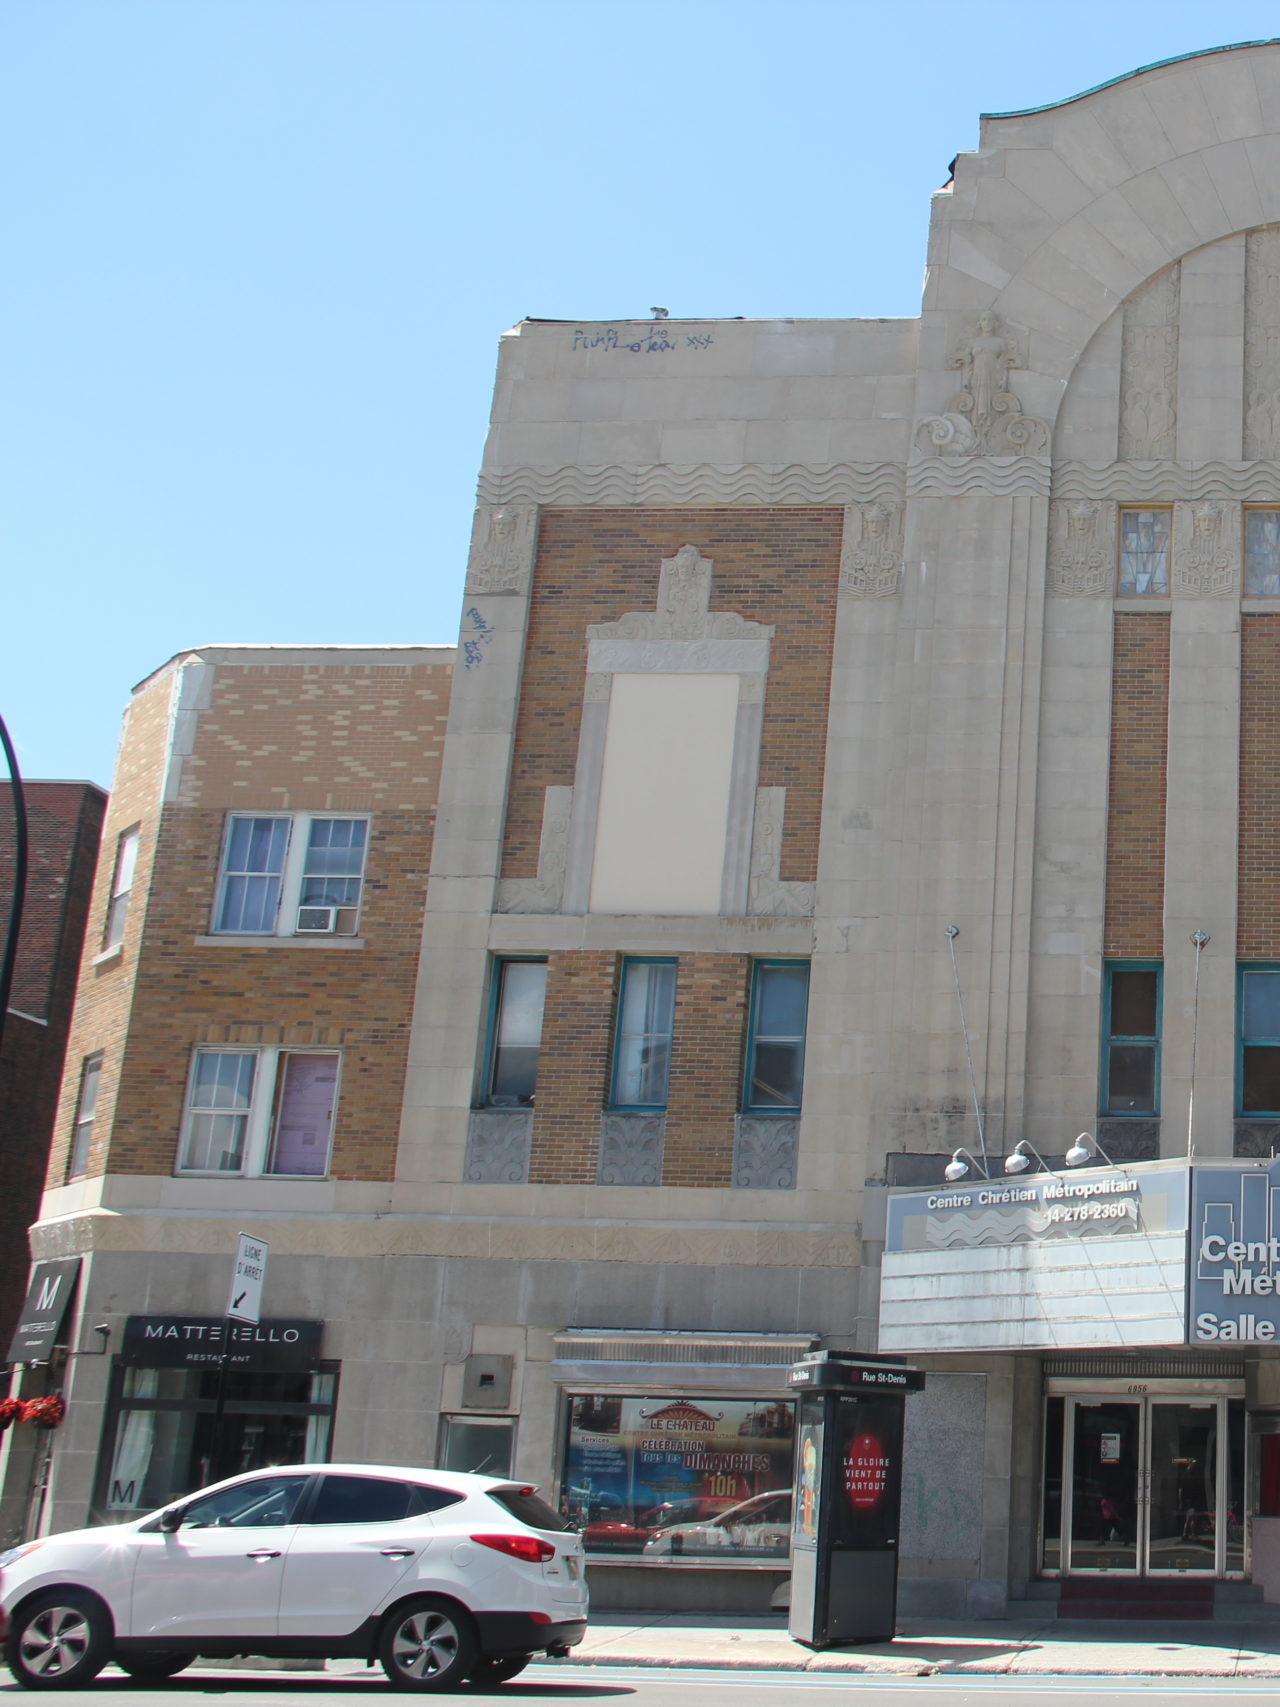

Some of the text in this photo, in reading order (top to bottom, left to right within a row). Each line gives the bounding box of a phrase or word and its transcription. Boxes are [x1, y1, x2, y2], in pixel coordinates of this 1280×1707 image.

[927, 1178, 1137, 1210] Centre Chrétien Métropolitain
[244, 1244, 262, 1262] LIGNE
[35, 1274, 62, 1311] M
[1196, 1312, 1276, 1342] Salle
[862, 1372, 907, 1384] Rue St-Denis
[1127, 1384, 1148, 1393] 6956
[650, 1419, 663, 1430] LE
[581, 1436, 610, 1444] Services
[683, 1453, 769, 1472] DIMANCHES
[843, 1457, 890, 1467] LA GLOIRE
[845, 1470, 887, 1479] VIENT DE
[111, 1480, 135, 1504] M
[709, 1474, 737, 1497] 10h
[846, 1482, 886, 1491] PARTOUT
